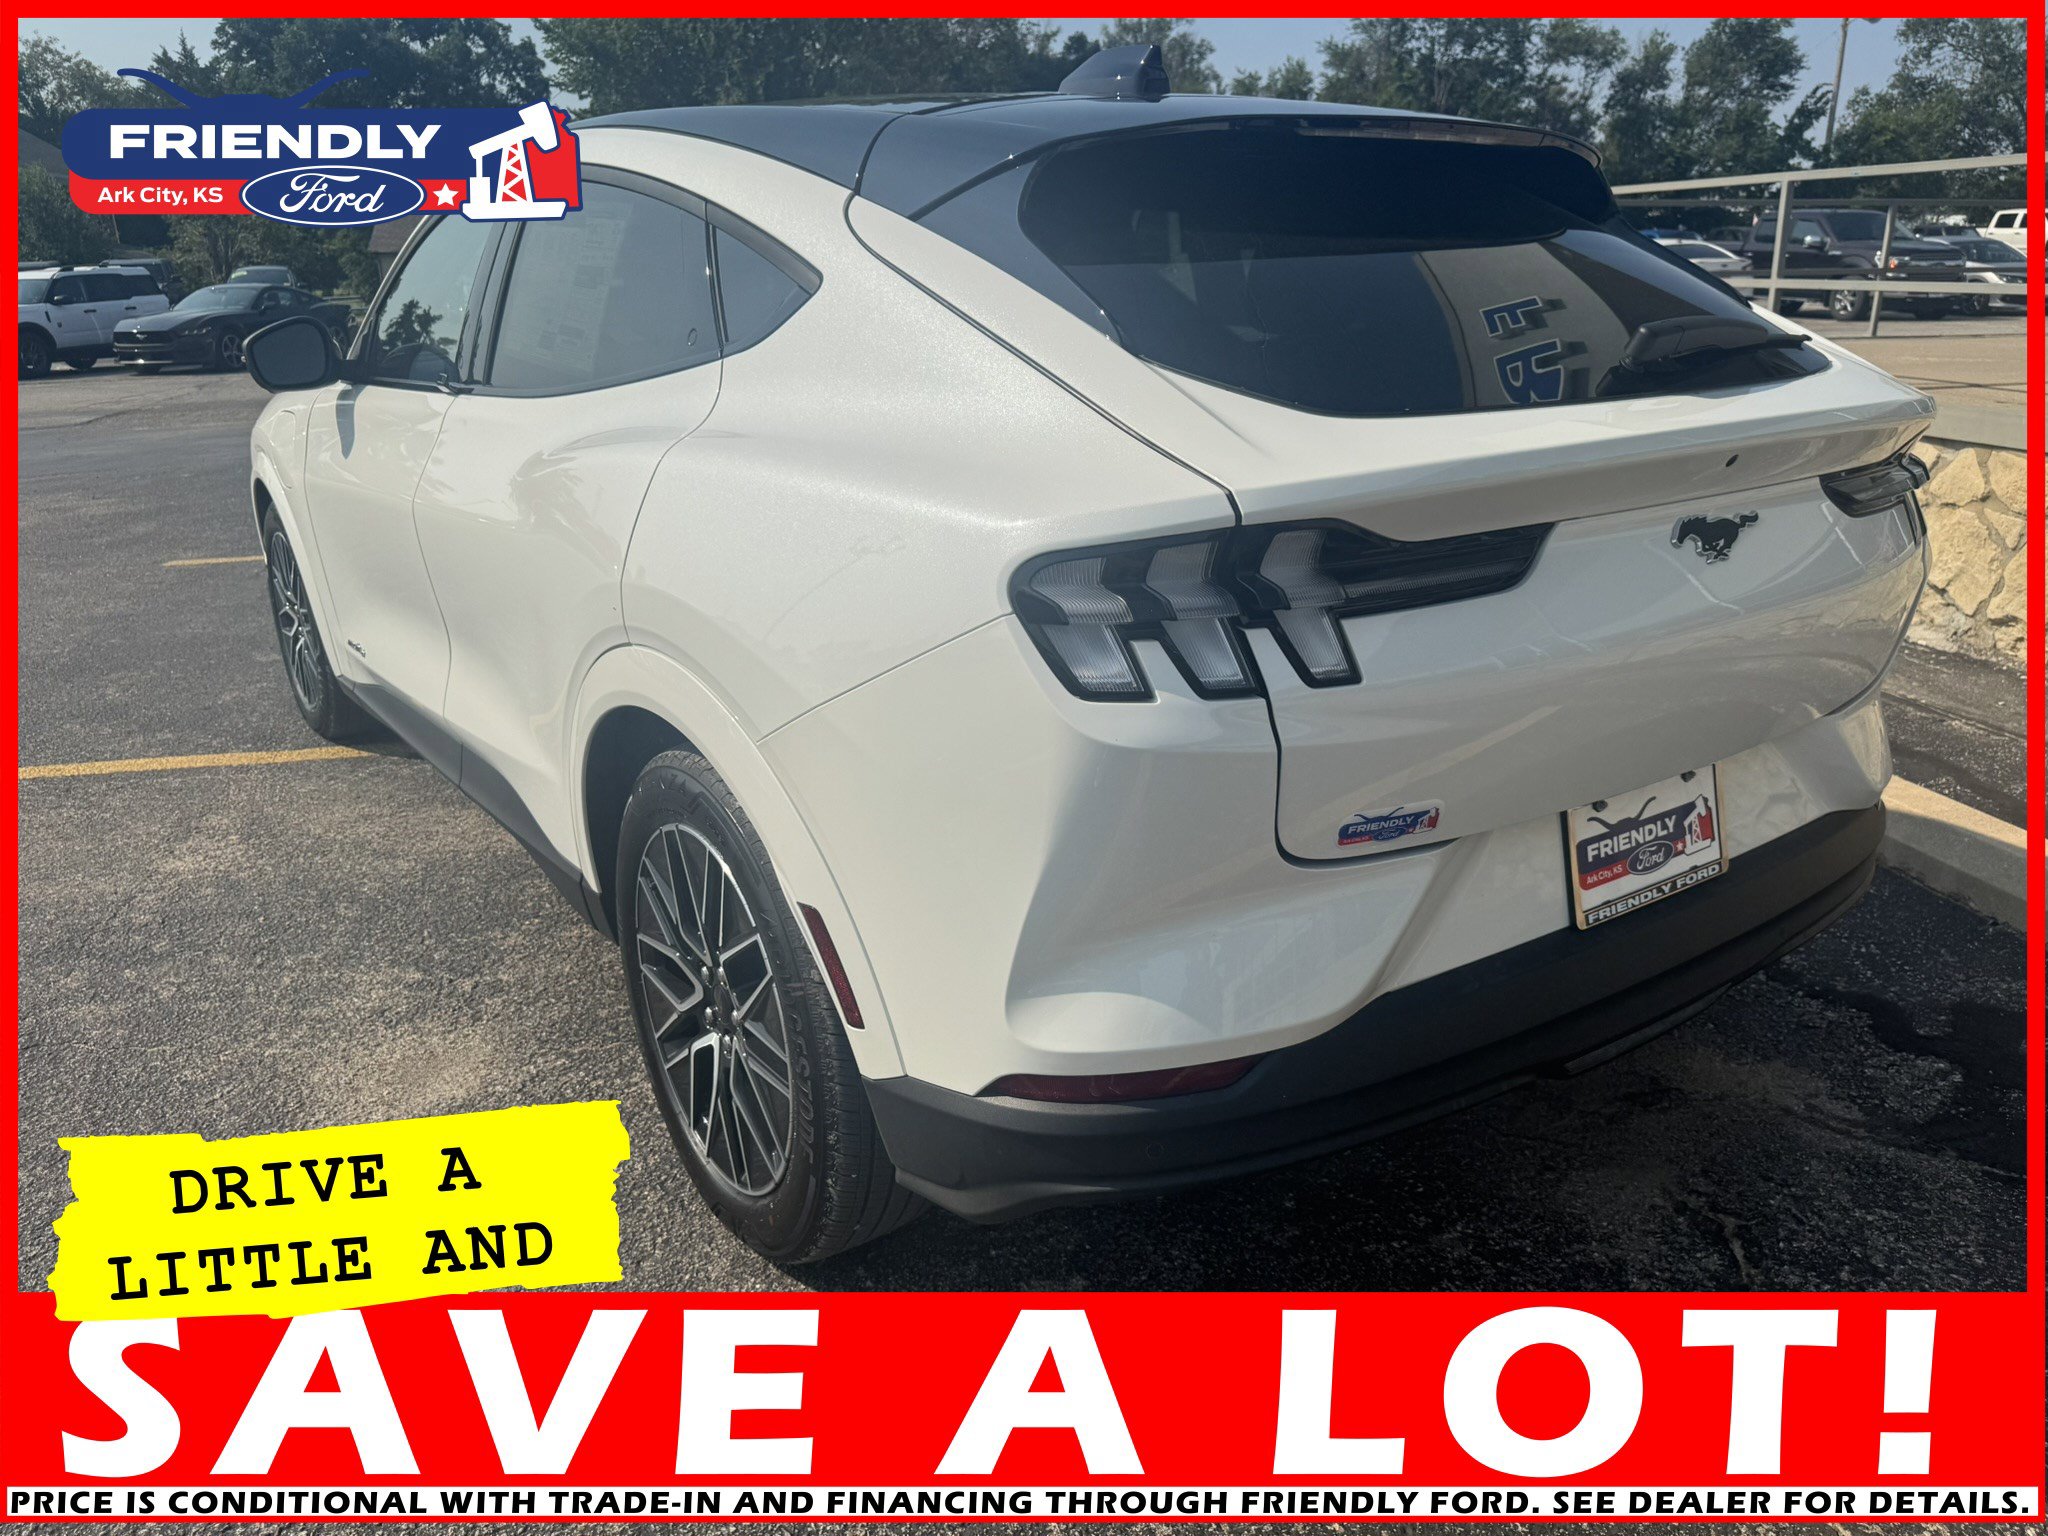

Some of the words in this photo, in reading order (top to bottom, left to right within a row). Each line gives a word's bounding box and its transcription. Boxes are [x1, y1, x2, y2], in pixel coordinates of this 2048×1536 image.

[1347, 815, 1415, 834] FRIENDLY
[1377, 829, 1400, 840] Ford
[1586, 815, 1677, 862] FRIENDLY
[1636, 846, 1665, 870] Ford
[1586, 873, 1599, 885] Ark
[1613, 864, 1623, 874] KS
[1588, 882, 1674, 924] FRIENDLY
[1676, 864, 1720, 889] FORD
